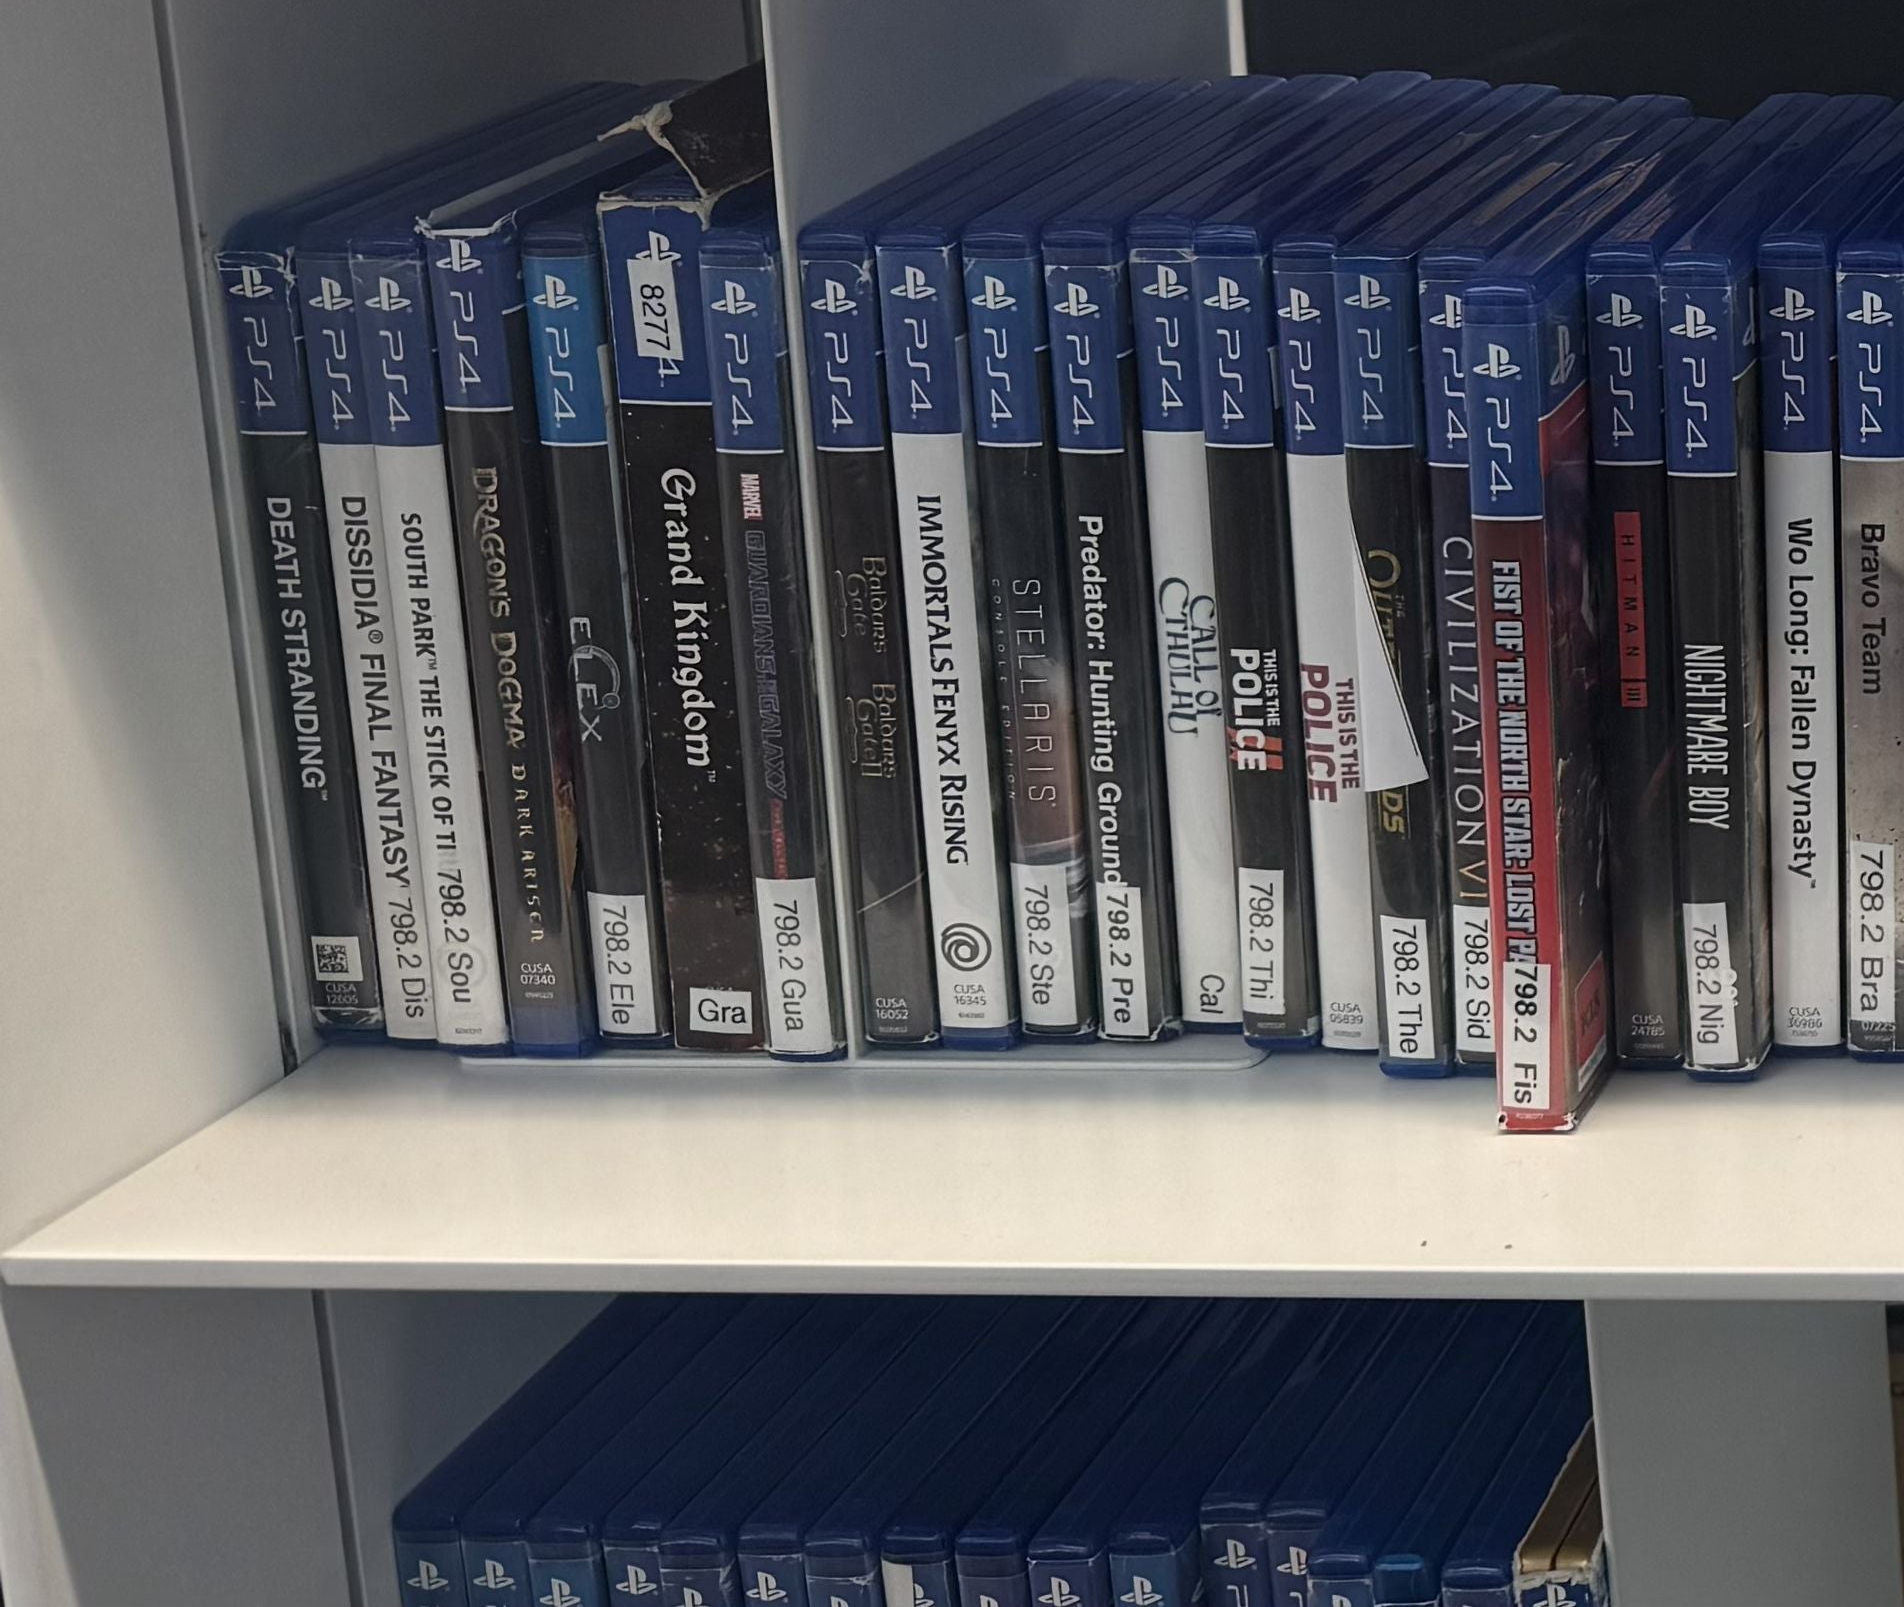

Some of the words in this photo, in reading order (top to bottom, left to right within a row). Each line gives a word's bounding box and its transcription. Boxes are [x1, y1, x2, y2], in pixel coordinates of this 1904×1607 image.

[638, 282, 670, 351] 8277
[267, 497, 302, 599] DEATH
[660, 467, 705, 587] Grand
[1788, 518, 1813, 564] Wo
[1860, 523, 1885, 608] Bravo
[917, 496, 954, 675] IMMORTALS
[1078, 516, 1110, 651] Predator:
[1785, 576, 1813, 656] Long:
[1861, 619, 1884, 694] Team
[932, 680, 961, 766] FENYX
[1087, 659, 1115, 774] Hunting
[1301, 663, 1337, 803] POLICE
[1685, 644, 1727, 776] NIGHTMARE
[1790, 665, 1816, 751] Fallen
[939, 775, 968, 865] RISING
[1688, 785, 1729, 830] BOY
[388, 895, 422, 970] 798.2
[437, 868, 470, 945] 798.2
[400, 977, 427, 1020] Dis
[447, 951, 471, 1003] Sou
[698, 1001, 746, 1025] Gra
[1513, 966, 1539, 1044] 798.2
[1513, 1061, 1532, 1104] Fis
